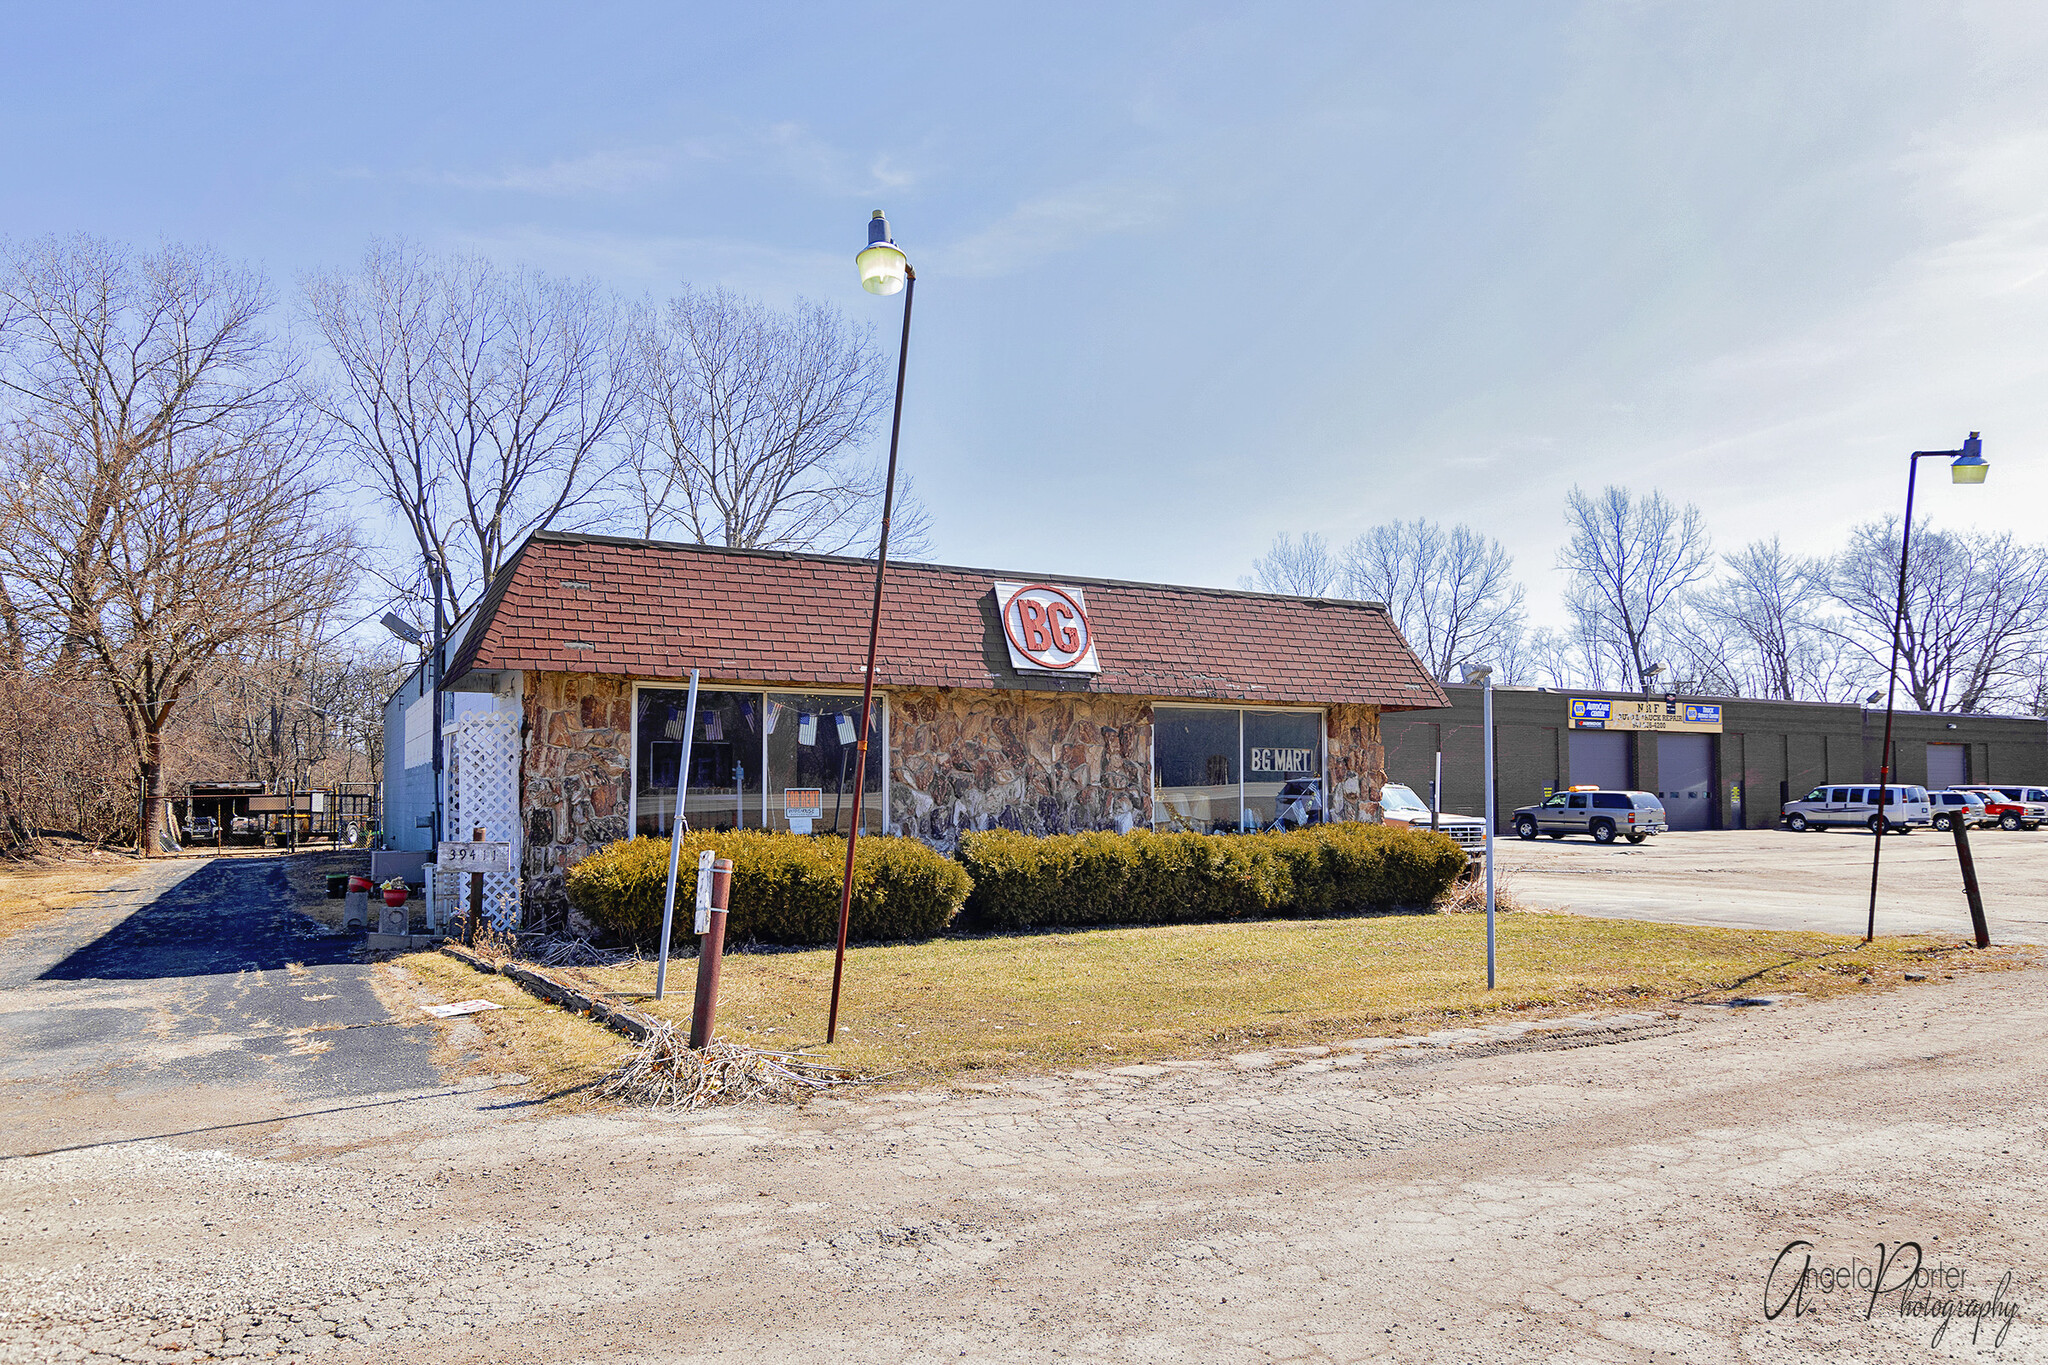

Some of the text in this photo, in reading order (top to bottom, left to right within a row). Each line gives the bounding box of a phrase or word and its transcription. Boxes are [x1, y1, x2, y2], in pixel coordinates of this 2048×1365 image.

[1017, 599, 1080, 654] BG
[1662, 714, 1683, 722] REPAIR
[1275, 749, 1310, 772] MART
[786, 791, 819, 808] FOR RENT
